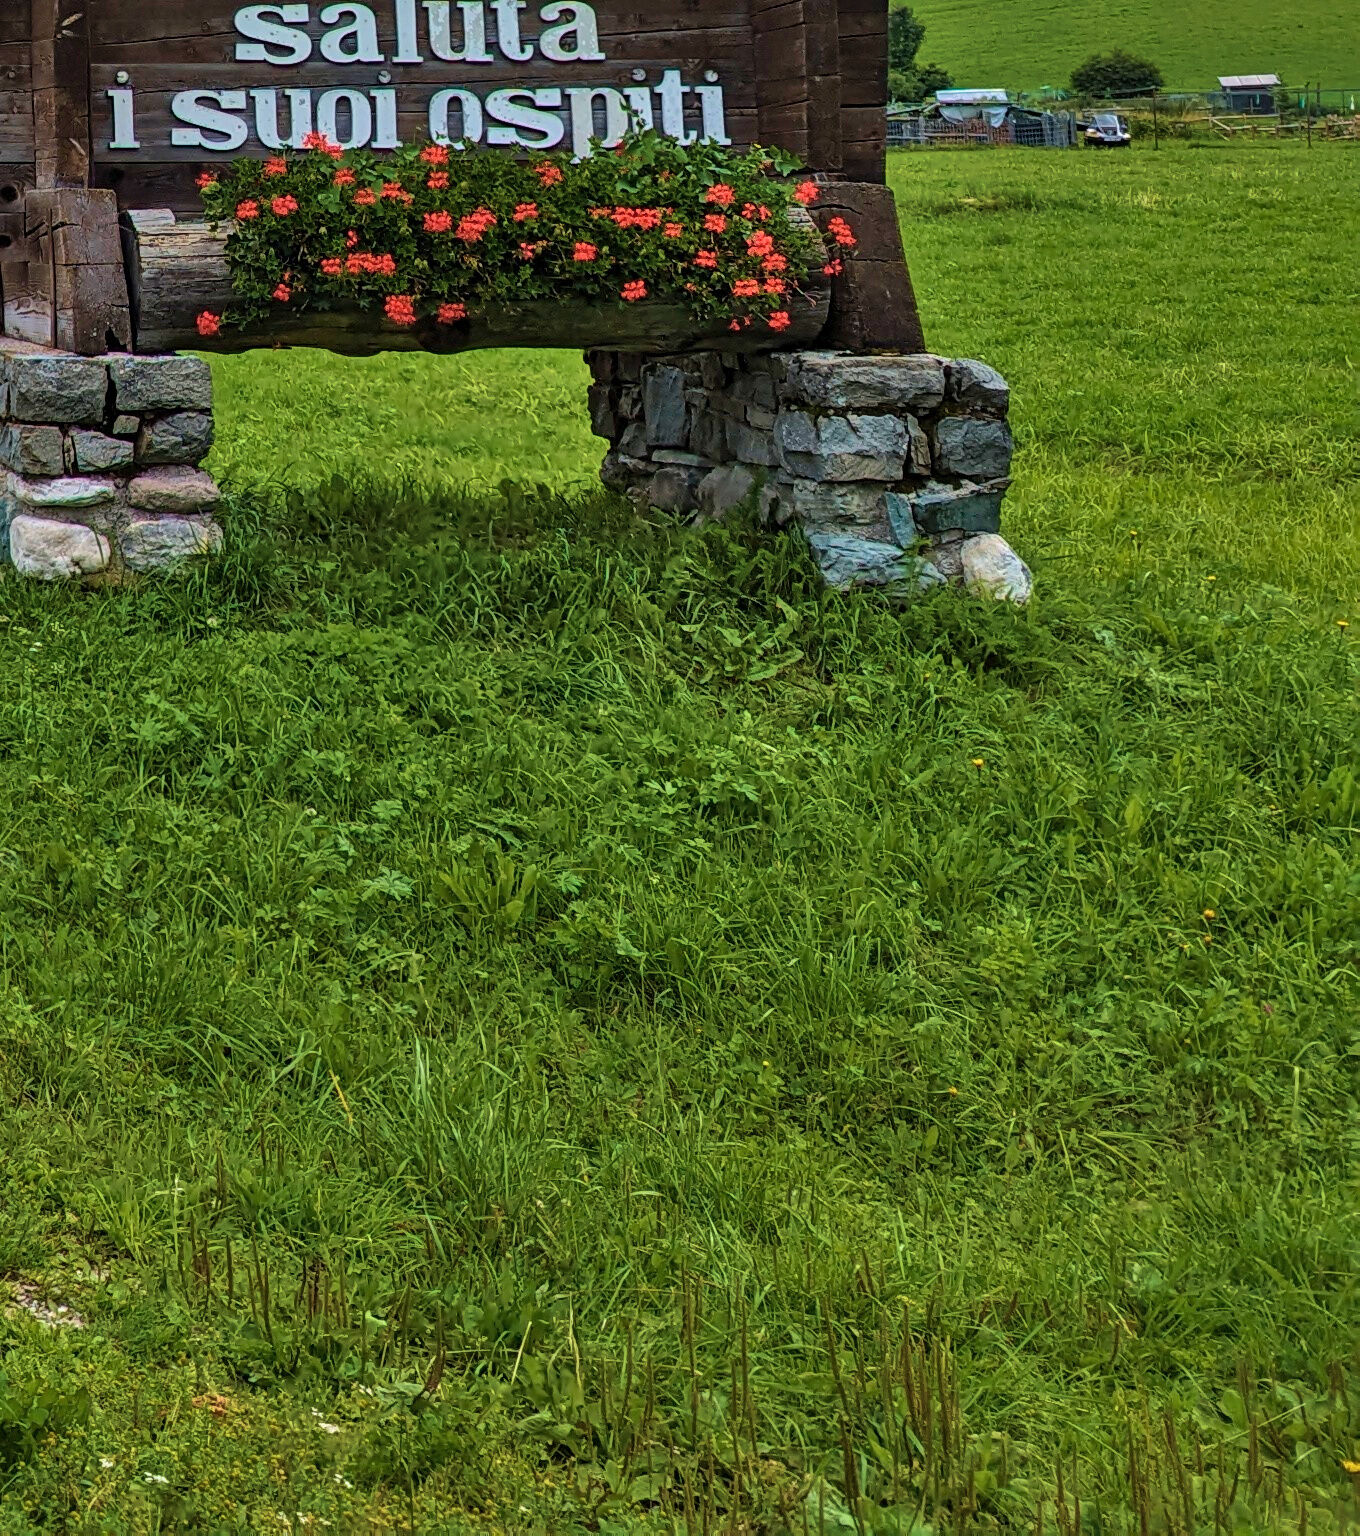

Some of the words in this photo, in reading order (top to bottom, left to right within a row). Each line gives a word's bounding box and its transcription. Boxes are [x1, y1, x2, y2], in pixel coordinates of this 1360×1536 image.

[106, 70, 140, 150] i
[171, 70, 403, 151] suoi
[427, 68, 732, 164] ospiti
